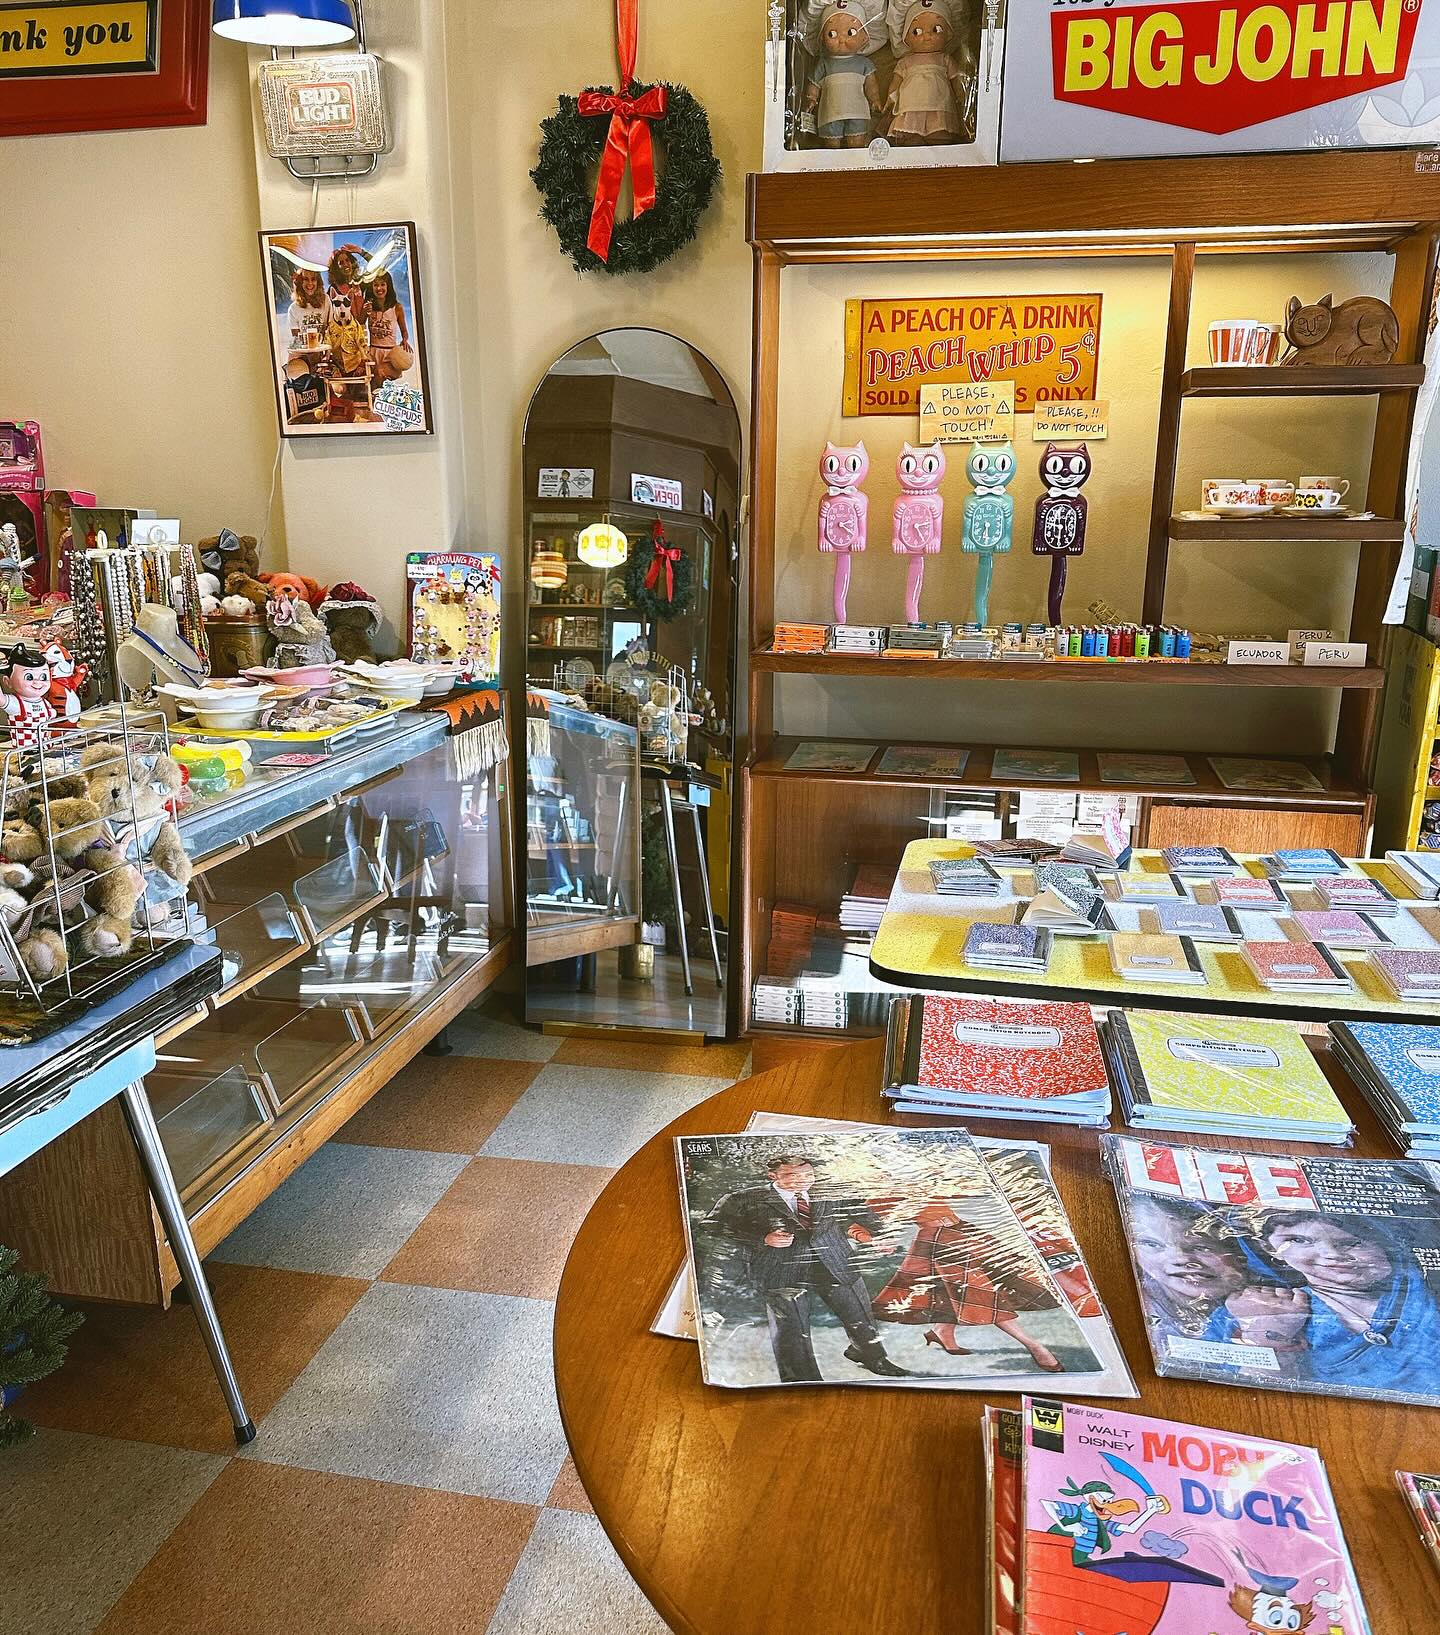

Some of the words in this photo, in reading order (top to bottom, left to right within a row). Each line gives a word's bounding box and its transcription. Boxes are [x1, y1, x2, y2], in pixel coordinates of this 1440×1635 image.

[64, 21, 133, 56] you
[1064, 11, 1184, 93] BIG
[1193, 0, 1402, 86] JOHN
[298, 88, 341, 106] BUD
[292, 104, 351, 122] LIGHT
[868, 310, 886, 333] A
[891, 308, 967, 332] PEACH
[969, 306, 999, 331] OF
[999, 307, 1017, 330] A
[1023, 304, 1097, 330] DRINK
[866, 335, 967, 386] PEACH
[966, 333, 1056, 384] WHIP
[865, 390, 911, 406] SOLD
[1036, 386, 1089, 401] ONLY
[942, 387, 995, 401] PLEASE,
[374, 401, 396, 415] CLUB
[395, 406, 422, 424] SPUDS
[943, 405, 959, 416] DO
[965, 405, 991, 415] NOT
[940, 419, 994, 433] TOUCH!
[1037, 422, 1048, 430] DO
[1051, 423, 1071, 432] NOT
[1073, 423, 1104, 433] TOUCH
[1299, 631, 1323, 640] PERU
[1236, 649, 1284, 660] ECUADOR
[1318, 648, 1350, 659] PERU
[687, 1143, 712, 1154] SEARS
[1334, 1162, 1395, 1172] Weapons
[1120, 1139, 1320, 1212] LIFE
[1309, 1172, 1365, 1180] Arsenal
[1311, 1179, 1363, 1188] Glories
[1345, 1188, 1382, 1196] First
[1383, 1190, 1423, 1198] Color
[1320, 1198, 1390, 1209] Murderer
[1323, 1205, 1358, 1213] Most
[1361, 1208, 1395, 1216] Foul
[1066, 1407, 1084, 1416] MOBY
[1086, 1410, 1105, 1419] DUCK
[1087, 1424, 1132, 1438] WALT
[1078, 1435, 1135, 1451] DISNEY
[1180, 1477, 1312, 1531] DUCK
